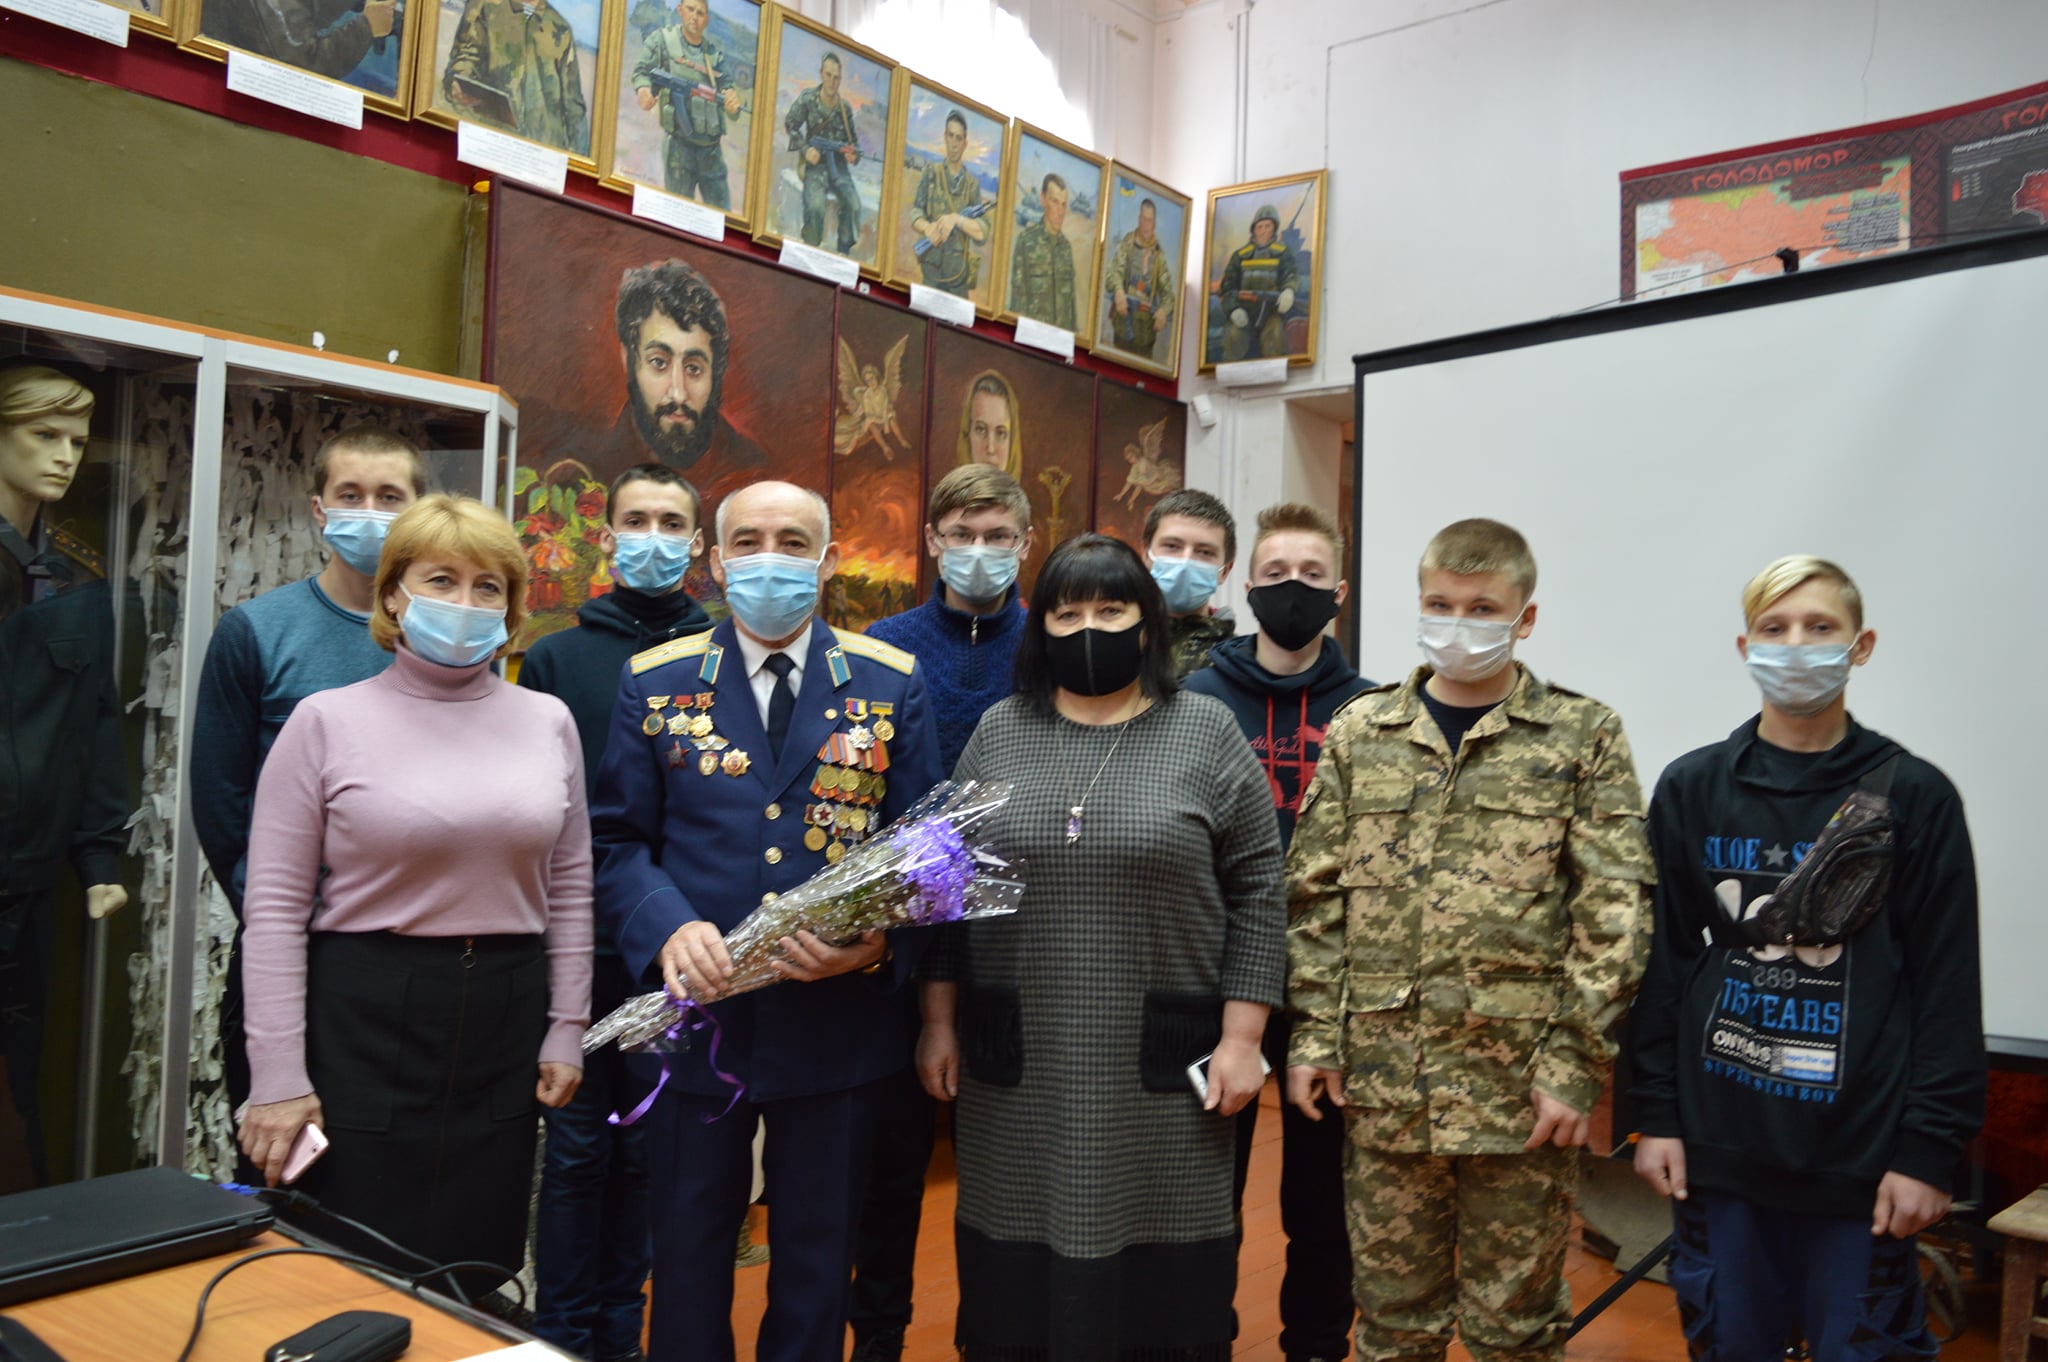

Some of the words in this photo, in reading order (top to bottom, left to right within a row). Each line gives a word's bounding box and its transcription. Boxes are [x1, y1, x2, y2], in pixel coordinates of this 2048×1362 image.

[1690, 149, 1850, 192] ГОЛОДОМОР
[1751, 993, 1842, 1036] YEARS
[1799, 1086, 1835, 1104] BOY
